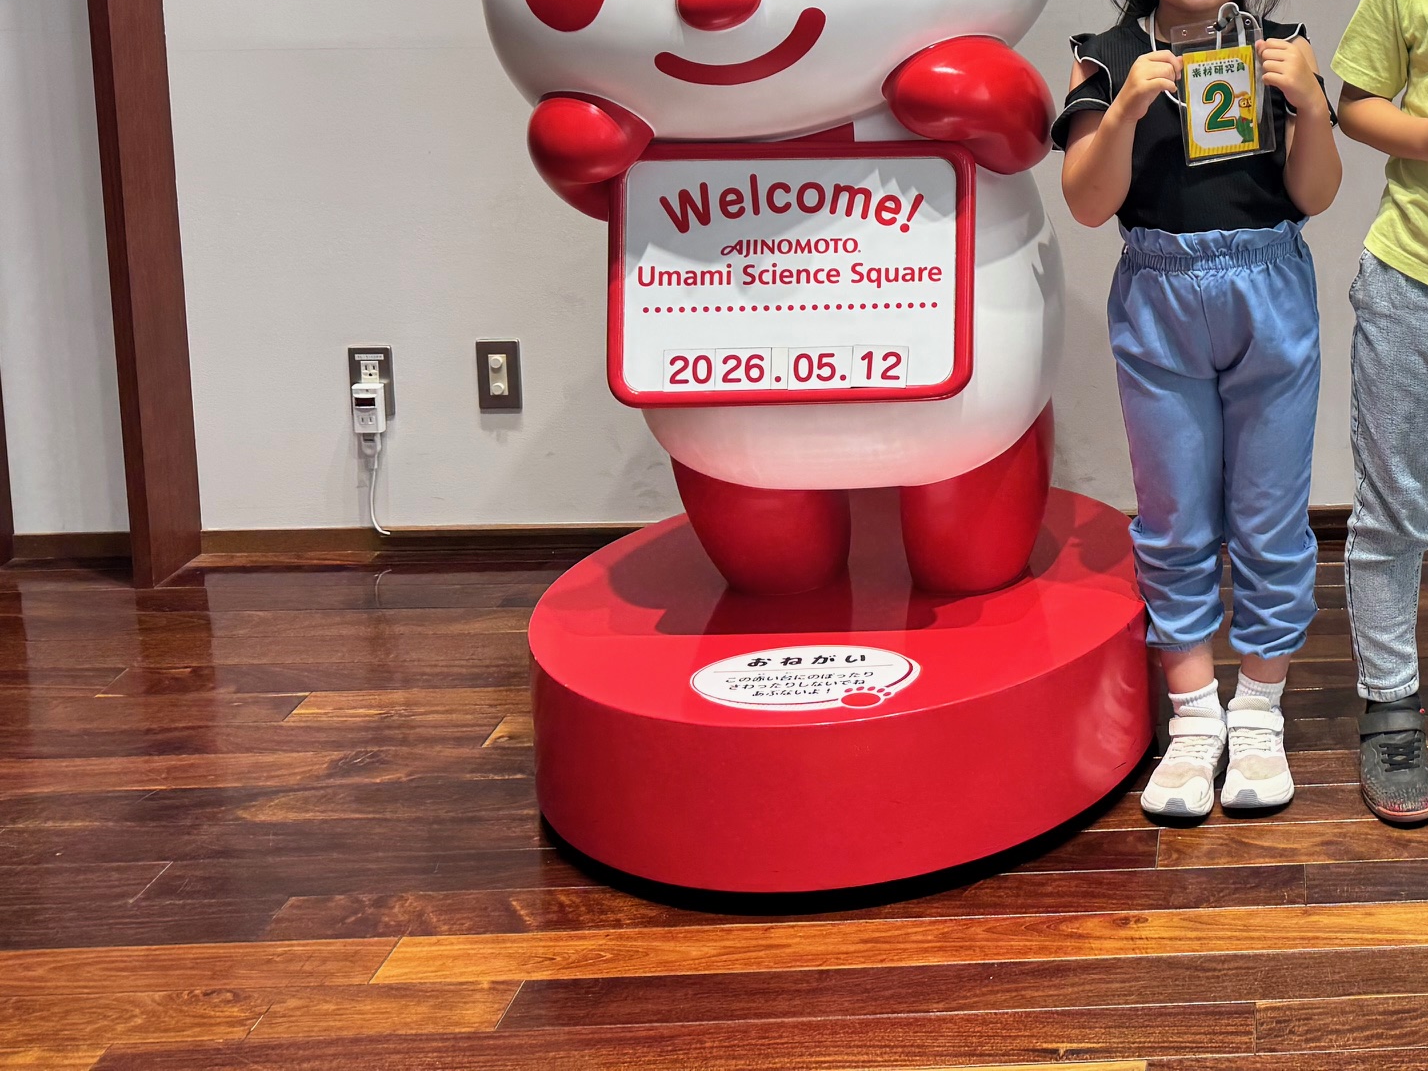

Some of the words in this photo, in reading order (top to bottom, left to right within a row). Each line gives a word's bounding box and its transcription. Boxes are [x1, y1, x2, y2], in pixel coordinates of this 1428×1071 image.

[1191, 61, 1246, 78] 素材研究員
[1202, 80, 1238, 133] 2
[659, 173, 925, 234] Welcome!
[637, 263, 733, 288] Umami
[742, 262, 842, 286] Science
[850, 262, 943, 290] Square
[747, 654, 867, 668] おねがい
